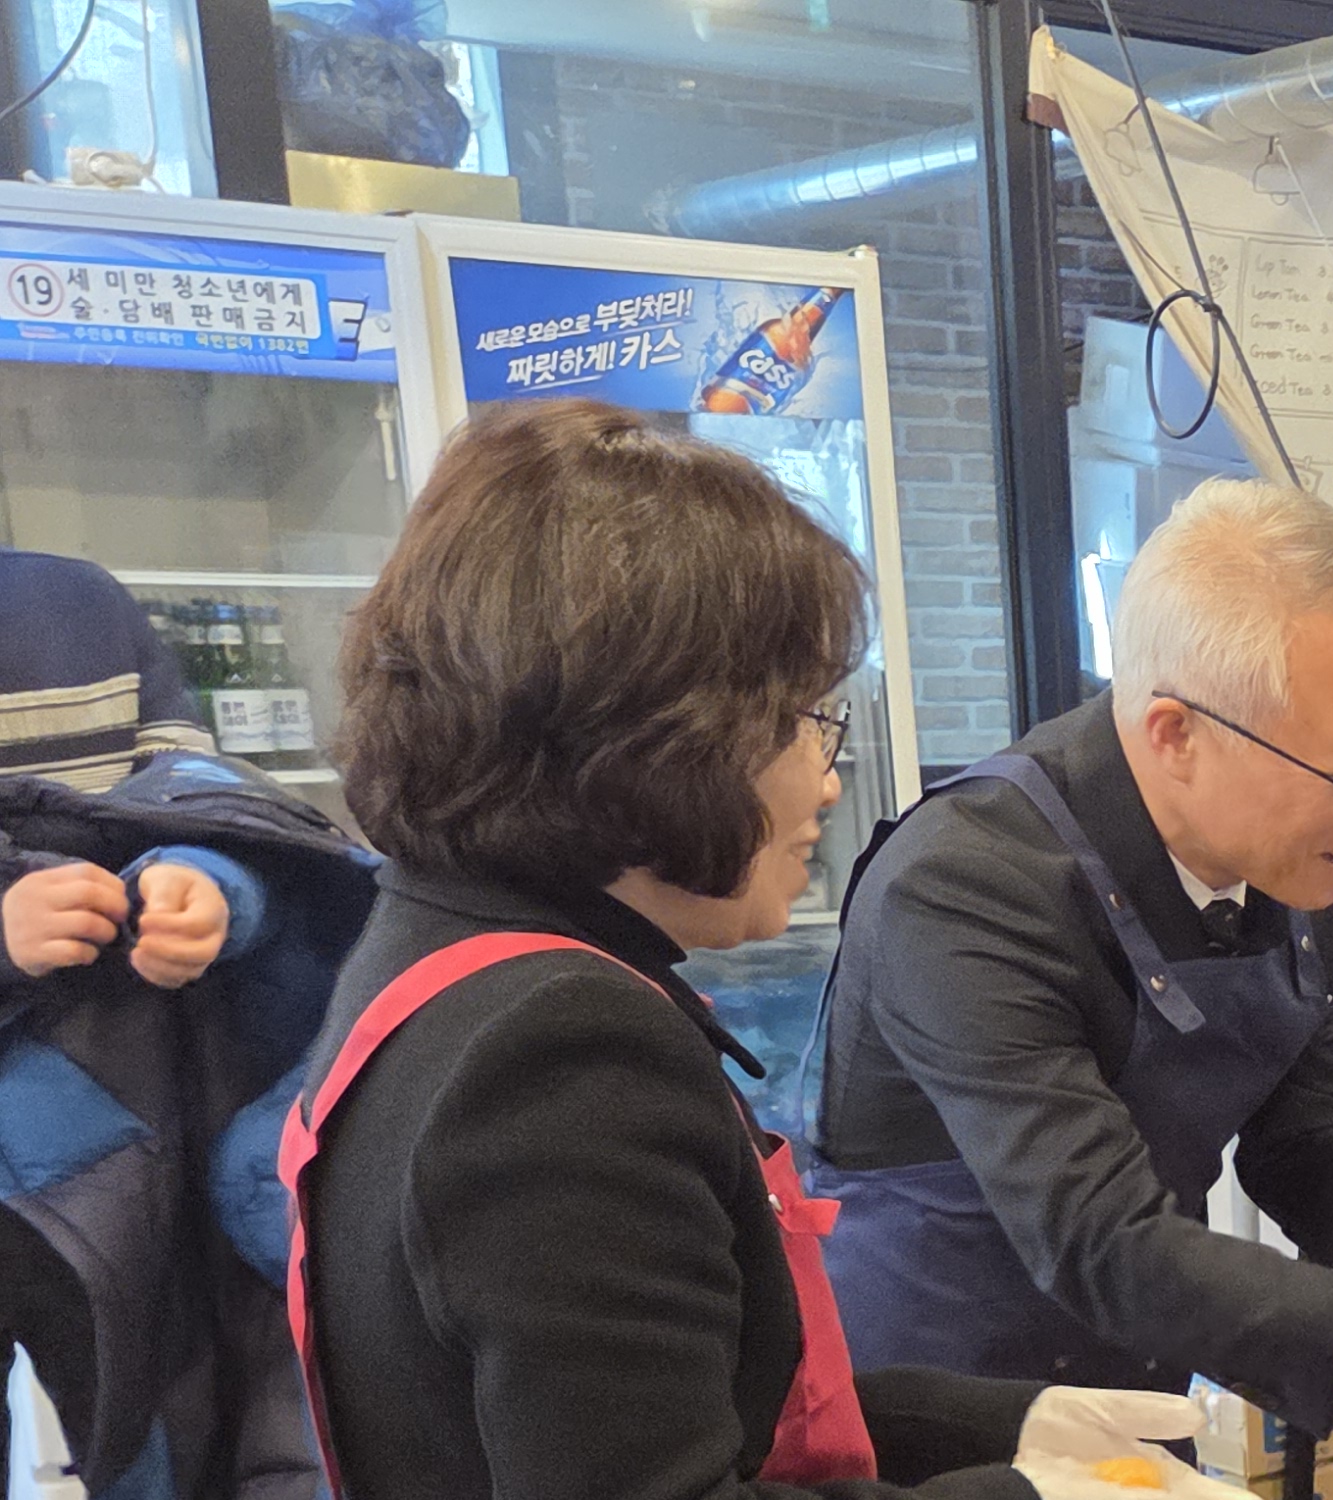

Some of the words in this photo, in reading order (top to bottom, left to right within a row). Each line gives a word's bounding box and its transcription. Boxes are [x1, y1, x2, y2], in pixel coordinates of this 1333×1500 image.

[15, 274, 53, 306] 19
[67, 266, 90, 293] 세
[105, 269, 157, 296] 미만
[171, 273, 303, 307] 청소년에게
[190, 304, 307, 334] 판매금지
[476, 325, 526, 351] 새로운
[526, 314, 591, 344] 모습으로
[594, 287, 694, 332] 부딪쳐라!
[507, 341, 616, 386] 짜릿하게!
[620, 329, 682, 371] 카스
[739, 349, 795, 389] Cass
